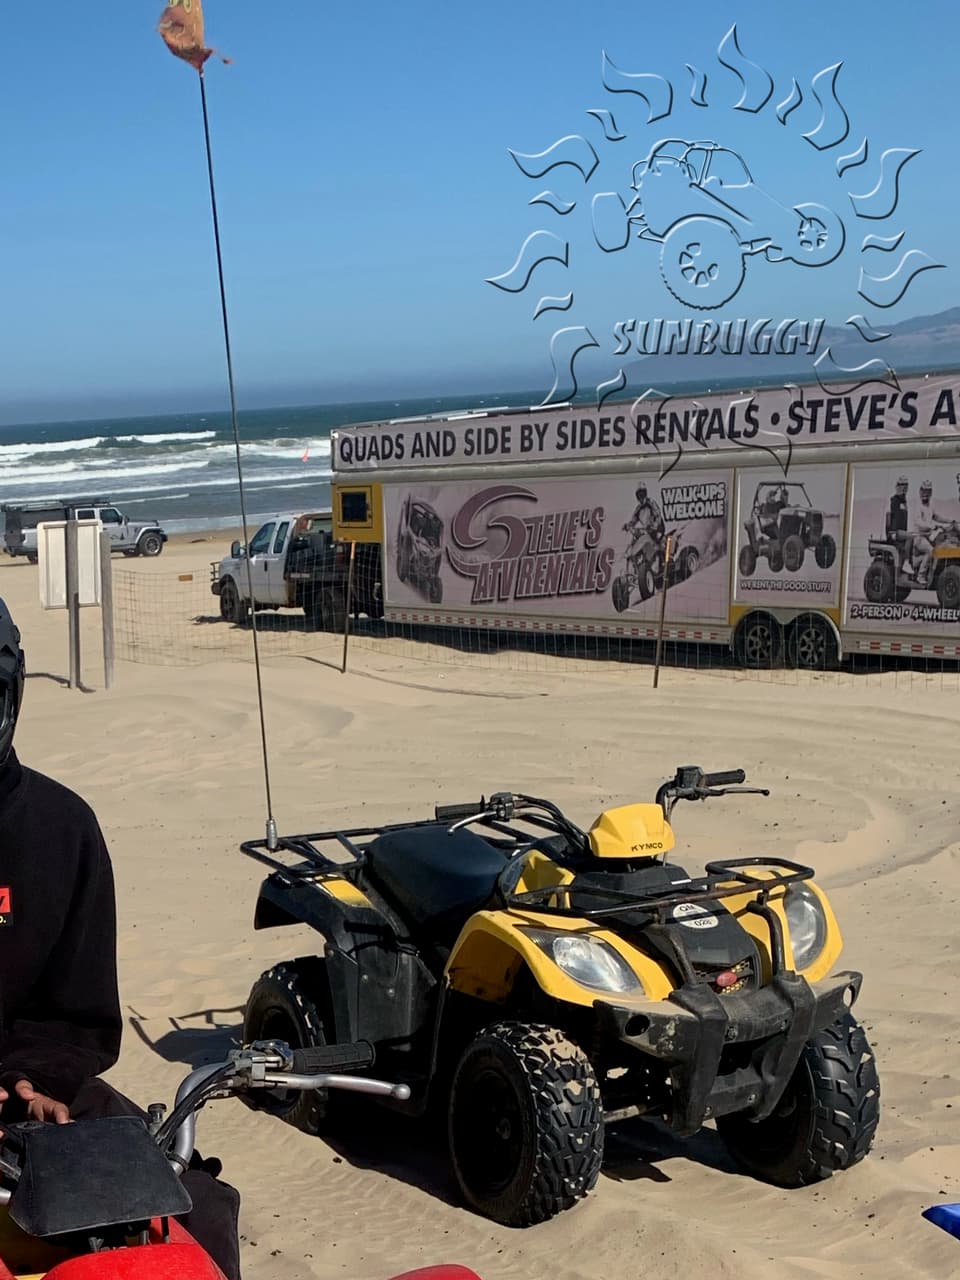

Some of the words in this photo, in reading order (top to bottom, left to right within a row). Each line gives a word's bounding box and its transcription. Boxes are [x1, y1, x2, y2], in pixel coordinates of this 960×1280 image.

[340, 433, 404, 464] QUADS
[411, 430, 457, 458] AND
[464, 425, 511, 456] SIDE
[520, 422, 550, 452] BY
[556, 416, 626, 450] SIDES
[636, 404, 759, 445] RENTALS
[787, 391, 919, 435] STEVE'S
[929, 388, 960, 427] A
[662, 483, 726, 505] WALK-UPS
[663, 499, 725, 521] WELCOME
[471, 558, 517, 604] ATV
[514, 548, 617, 600] RENTALS
[784, 581, 807, 592] GOOD
[851, 604, 903, 619] 2-PERSON
[631, 841, 663, 852] KYMCO
